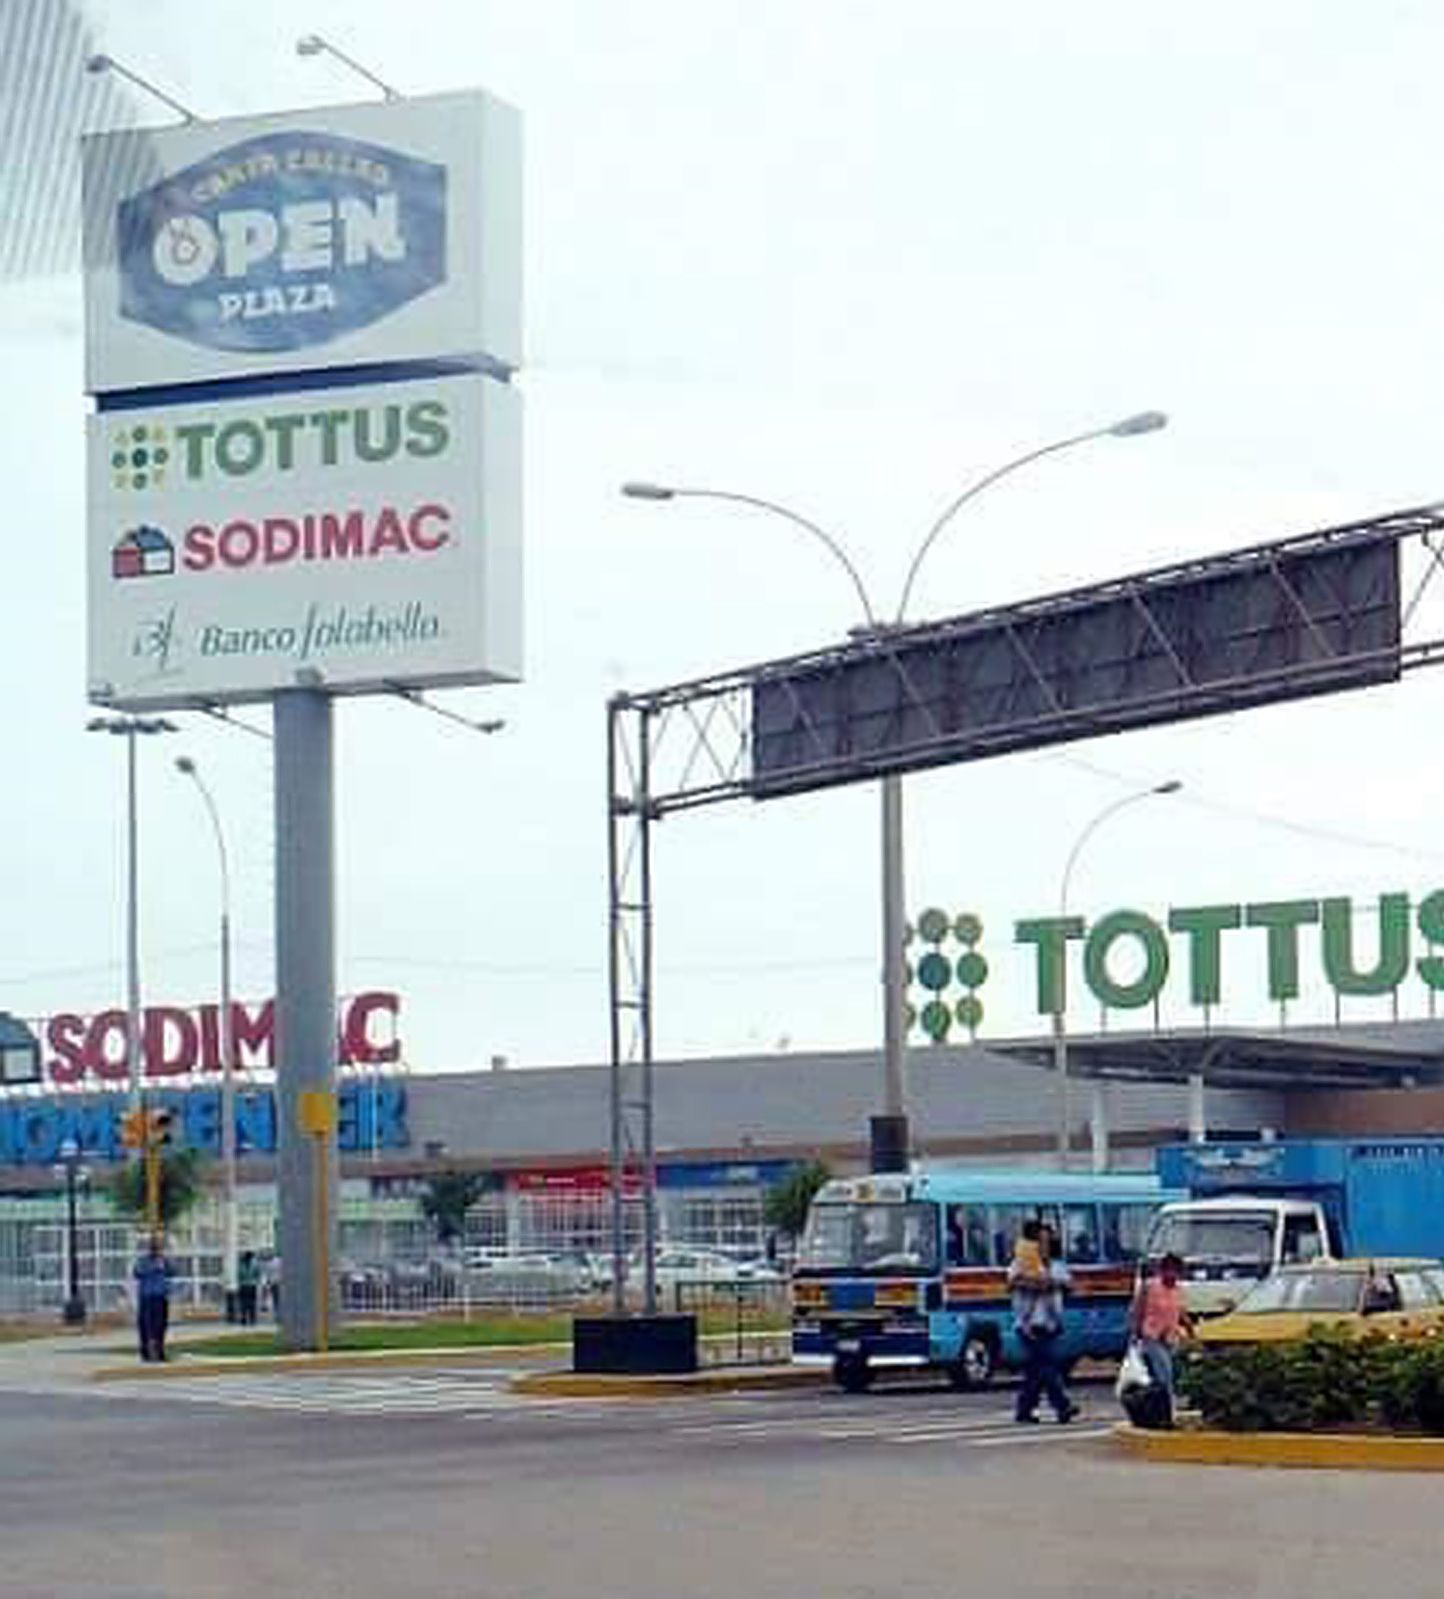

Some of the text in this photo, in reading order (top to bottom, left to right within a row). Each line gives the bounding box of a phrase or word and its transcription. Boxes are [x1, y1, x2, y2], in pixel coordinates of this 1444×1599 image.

[153, 193, 406, 287] OPEN
[218, 283, 333, 321] PLAZA
[174, 401, 449, 479] TOTTUS
[182, 503, 451, 572] SODIMAC
[200, 624, 296, 656] Banco
[48, 992, 400, 1084] SODIMC
